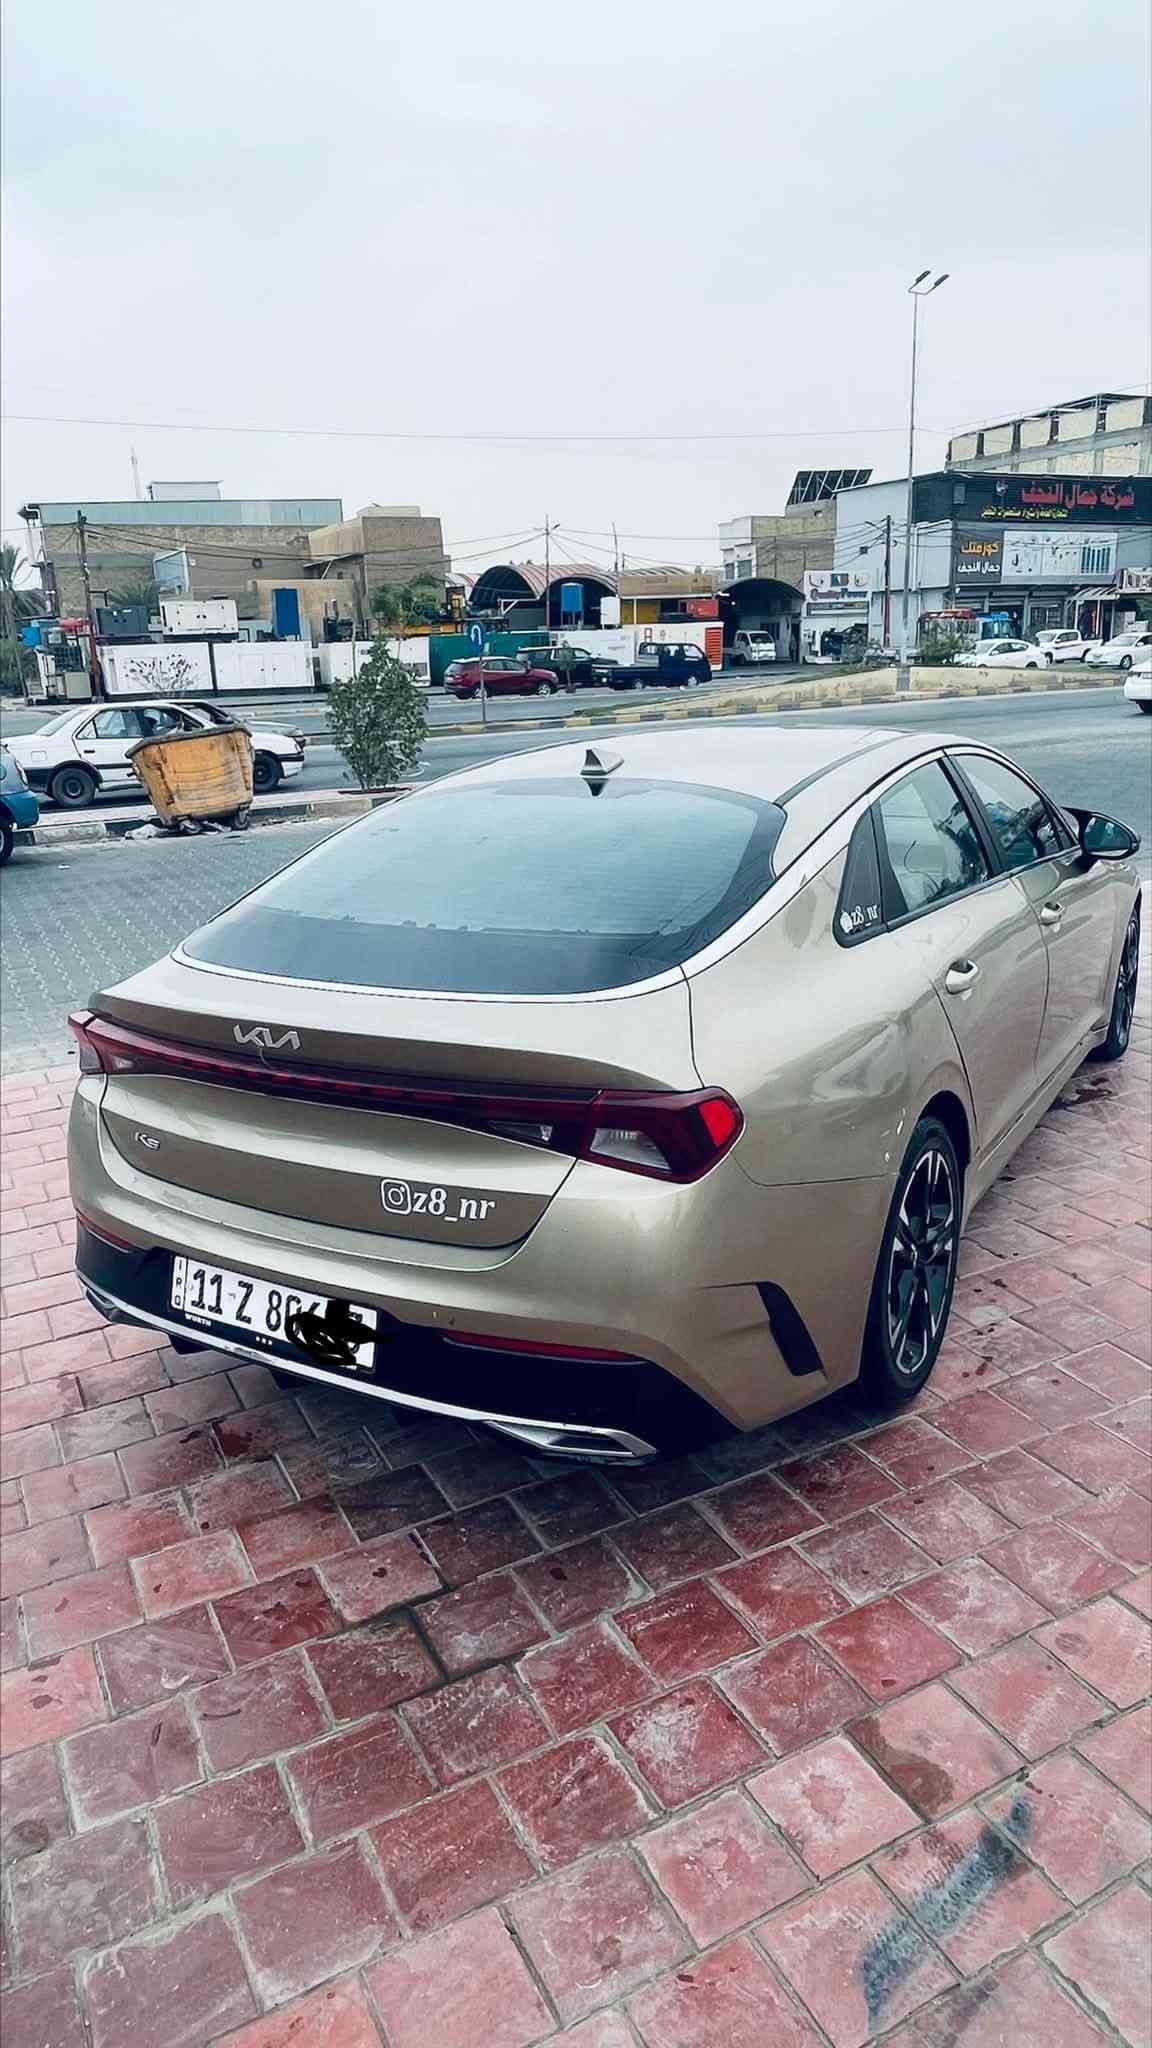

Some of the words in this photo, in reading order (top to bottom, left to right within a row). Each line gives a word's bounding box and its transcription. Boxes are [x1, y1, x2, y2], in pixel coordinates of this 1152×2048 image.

[1022, 480, 1064, 506] النجف
[1065, 484, 1098, 509] جمال
[1101, 483, 1135, 511] شركة
[232, 1024, 301, 1050] KIA
[412, 1187, 496, 1222] z8_nr
[191, 1268, 223, 1315] 11
